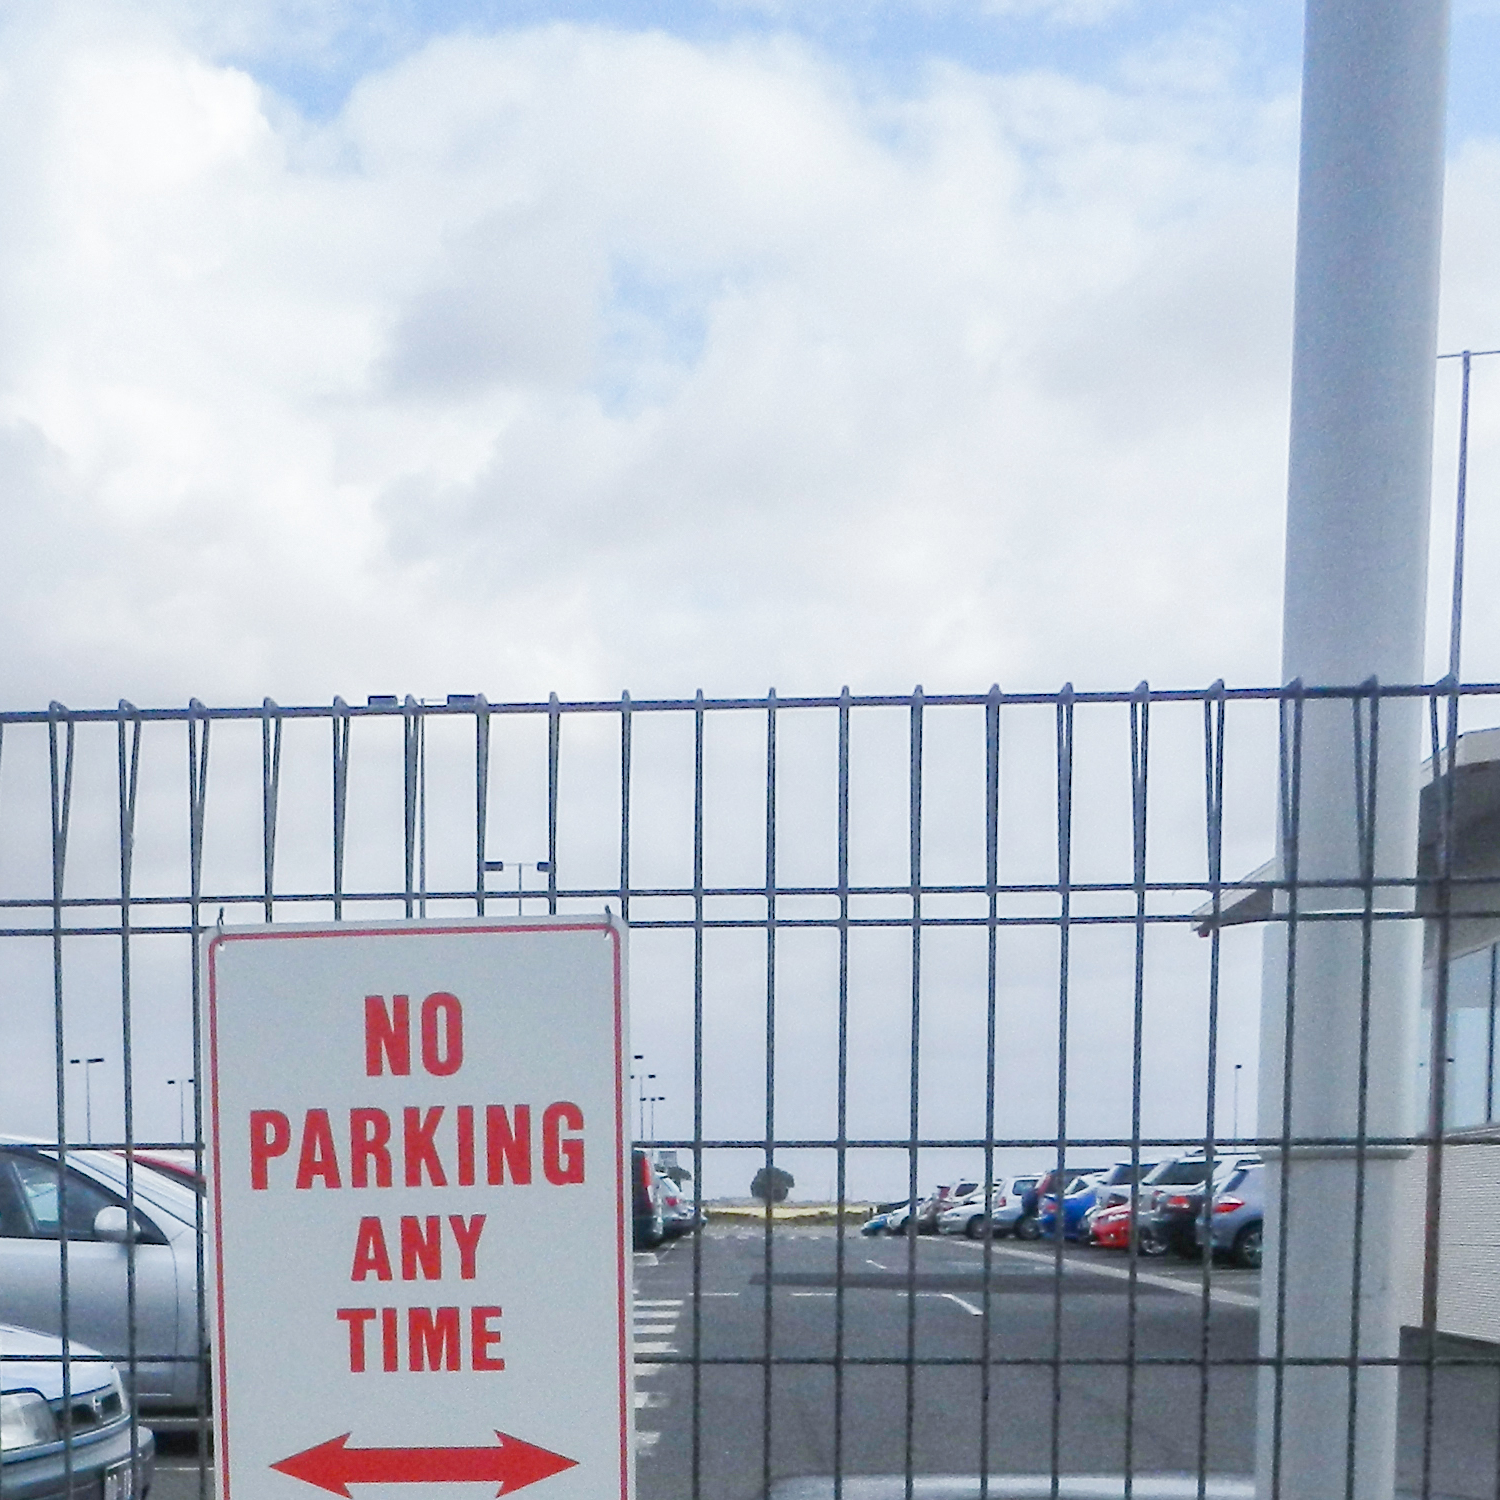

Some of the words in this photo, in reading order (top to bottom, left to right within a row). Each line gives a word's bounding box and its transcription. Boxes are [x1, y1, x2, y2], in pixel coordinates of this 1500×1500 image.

[365, 993, 463, 1077] NO
[250, 1103, 585, 1191] PARKING
[351, 1215, 485, 1282] ANY
[336, 1307, 505, 1373] TIME
